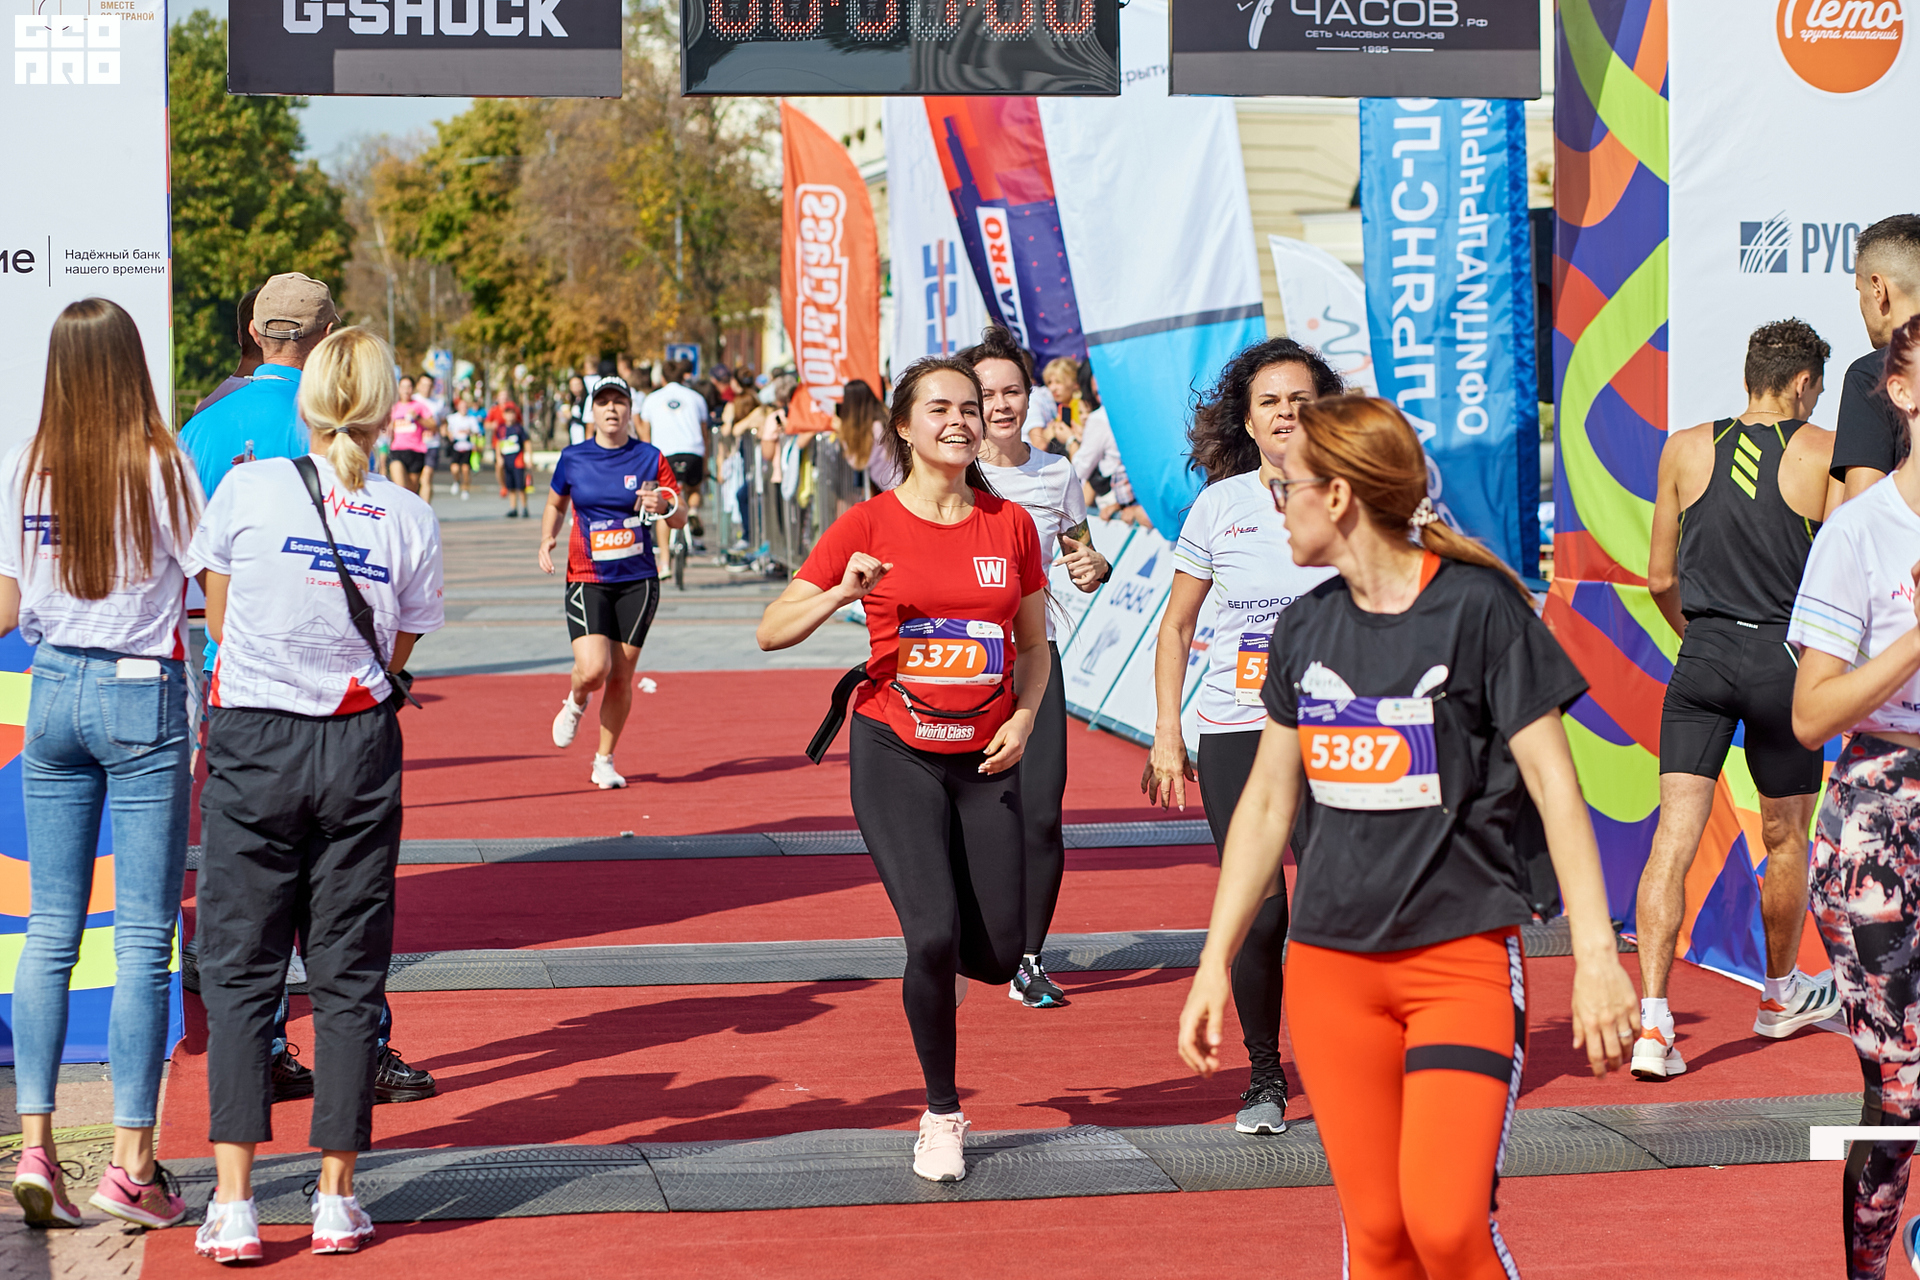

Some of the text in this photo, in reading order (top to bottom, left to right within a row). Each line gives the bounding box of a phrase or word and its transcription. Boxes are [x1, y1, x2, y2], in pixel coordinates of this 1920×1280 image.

[100, 1, 135, 10] ВМЕСТЕ
[115, 11, 155, 21] ТРАНОЙ
[282, 0, 569, 37] G-SHOCK
[1305, 30, 1445, 40] СЕТЬ ЧАСОВЫХ САЛОНОВ
[1799, 29, 1899, 43] группа компаний
[65, 248, 160, 262] Надёжный банк
[1802, 222, 1877, 275] РУС
[65, 265, 165, 276] нашего времени
[595, 530, 633, 548] 5469
[979, 560, 1002, 584] W
[305, 576, 316, 585] 12
[906, 643, 978, 669] 5371
[917, 724, 973, 739] World Class
[1310, 733, 1401, 772] 5387
